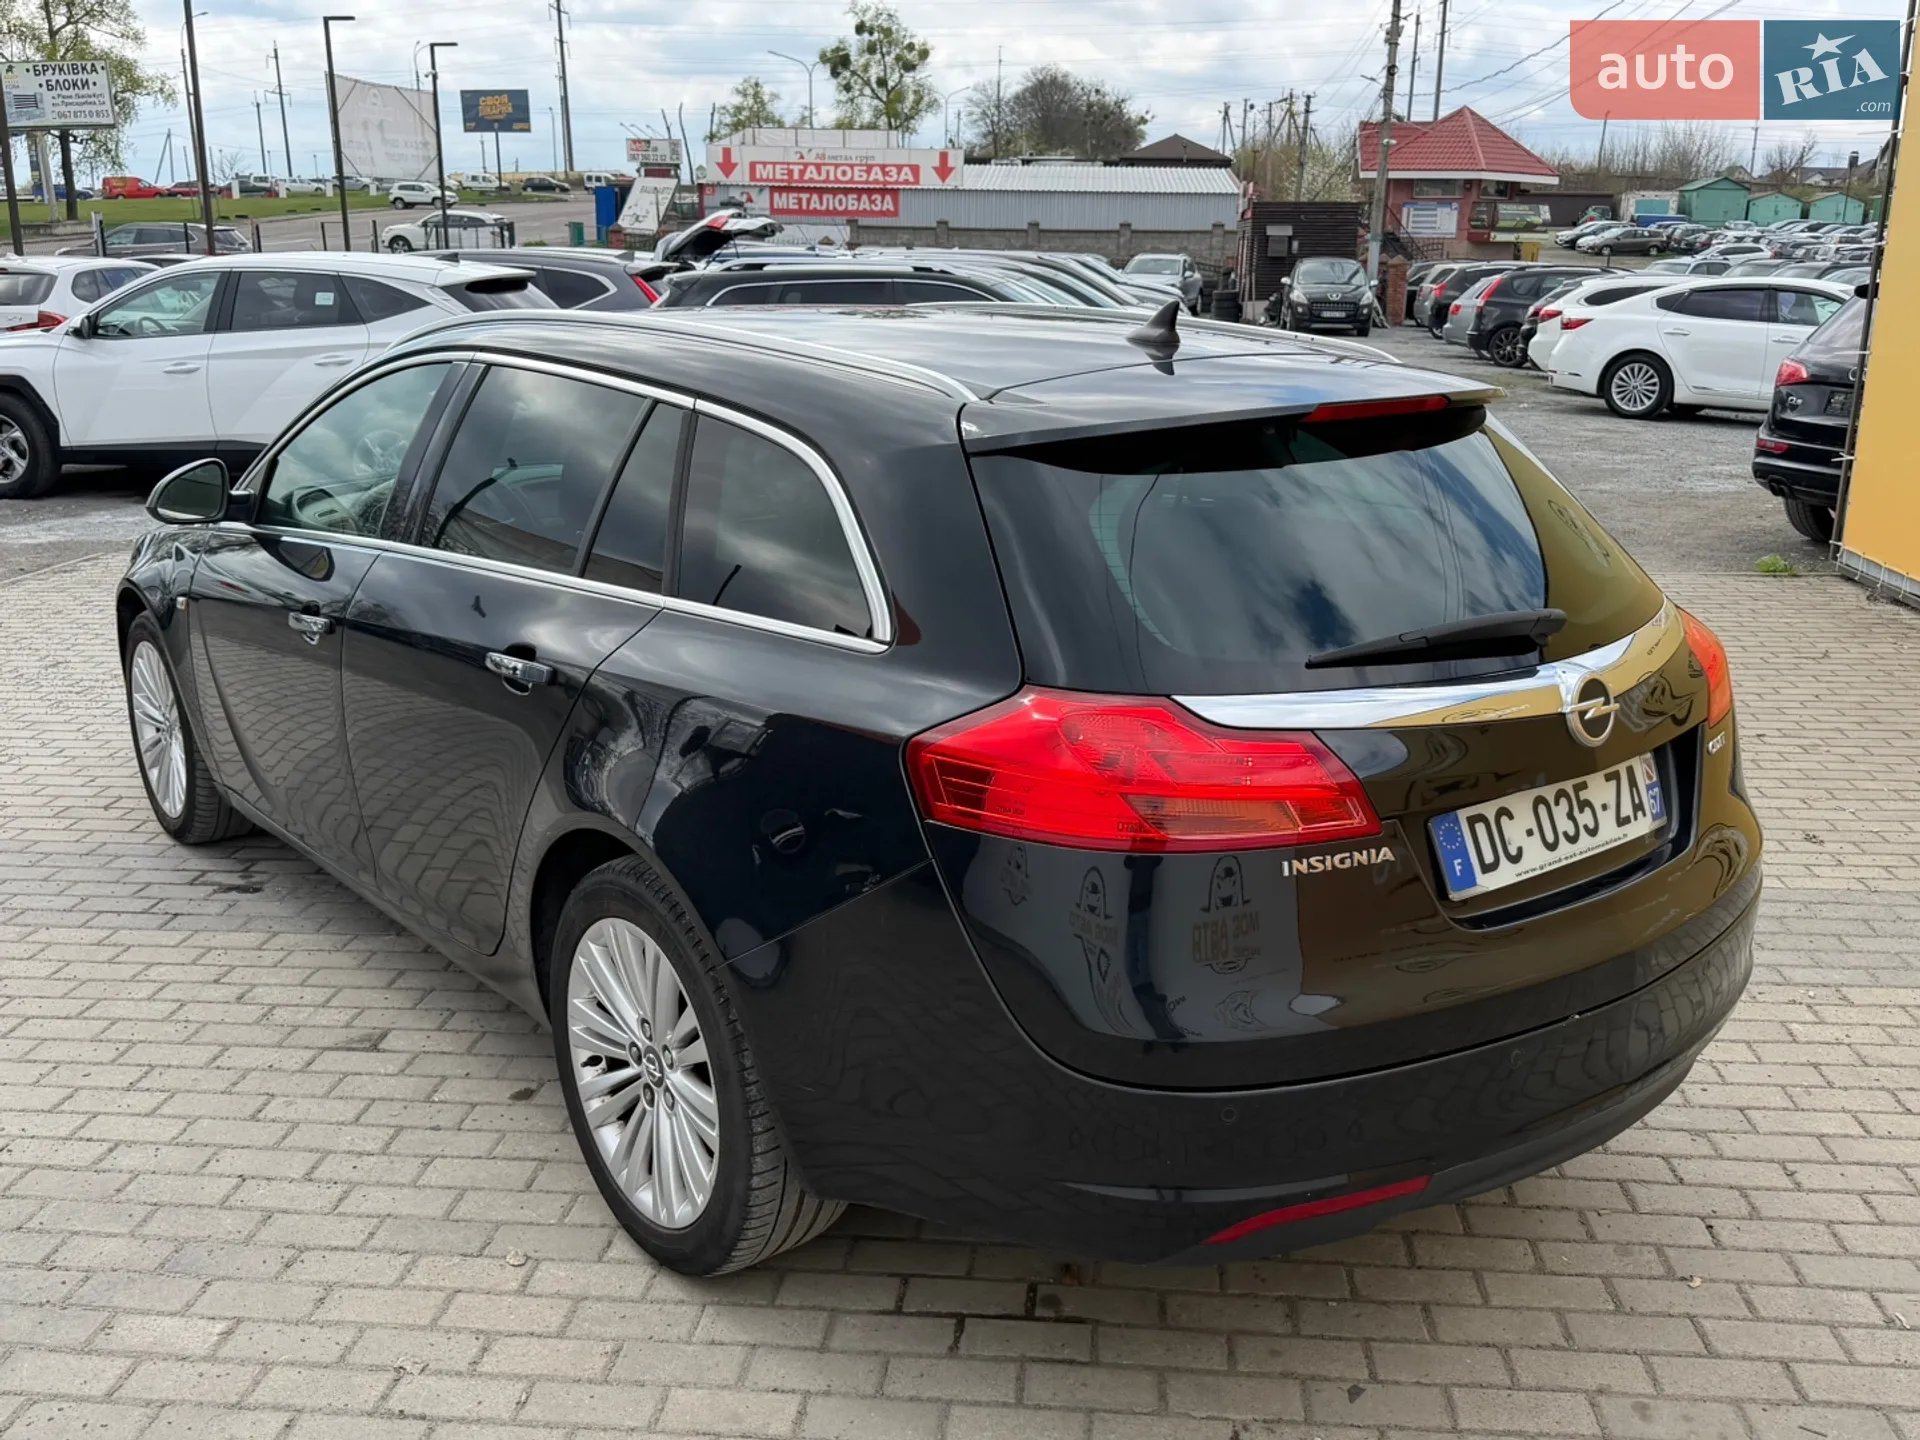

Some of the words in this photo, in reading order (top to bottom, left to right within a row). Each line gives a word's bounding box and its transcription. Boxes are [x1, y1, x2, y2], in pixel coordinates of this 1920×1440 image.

[32, 62, 99, 77] БРУКІВКА
[46, 78, 90, 91] БЛОКИ
[57, 110, 71, 119] 067
[755, 163, 915, 182] МЕТАЛОБАЗА
[773, 192, 895, 212] МЕТАЛОБАЗА
[1648, 787, 1662, 814] 67
[1465, 764, 1647, 875] DC-035-ZA
[1281, 846, 1396, 877] INSIGNIA
[1515, 833, 1628, 877] www.grand-est-automobiles.fr
[1453, 858, 1463, 876] F
